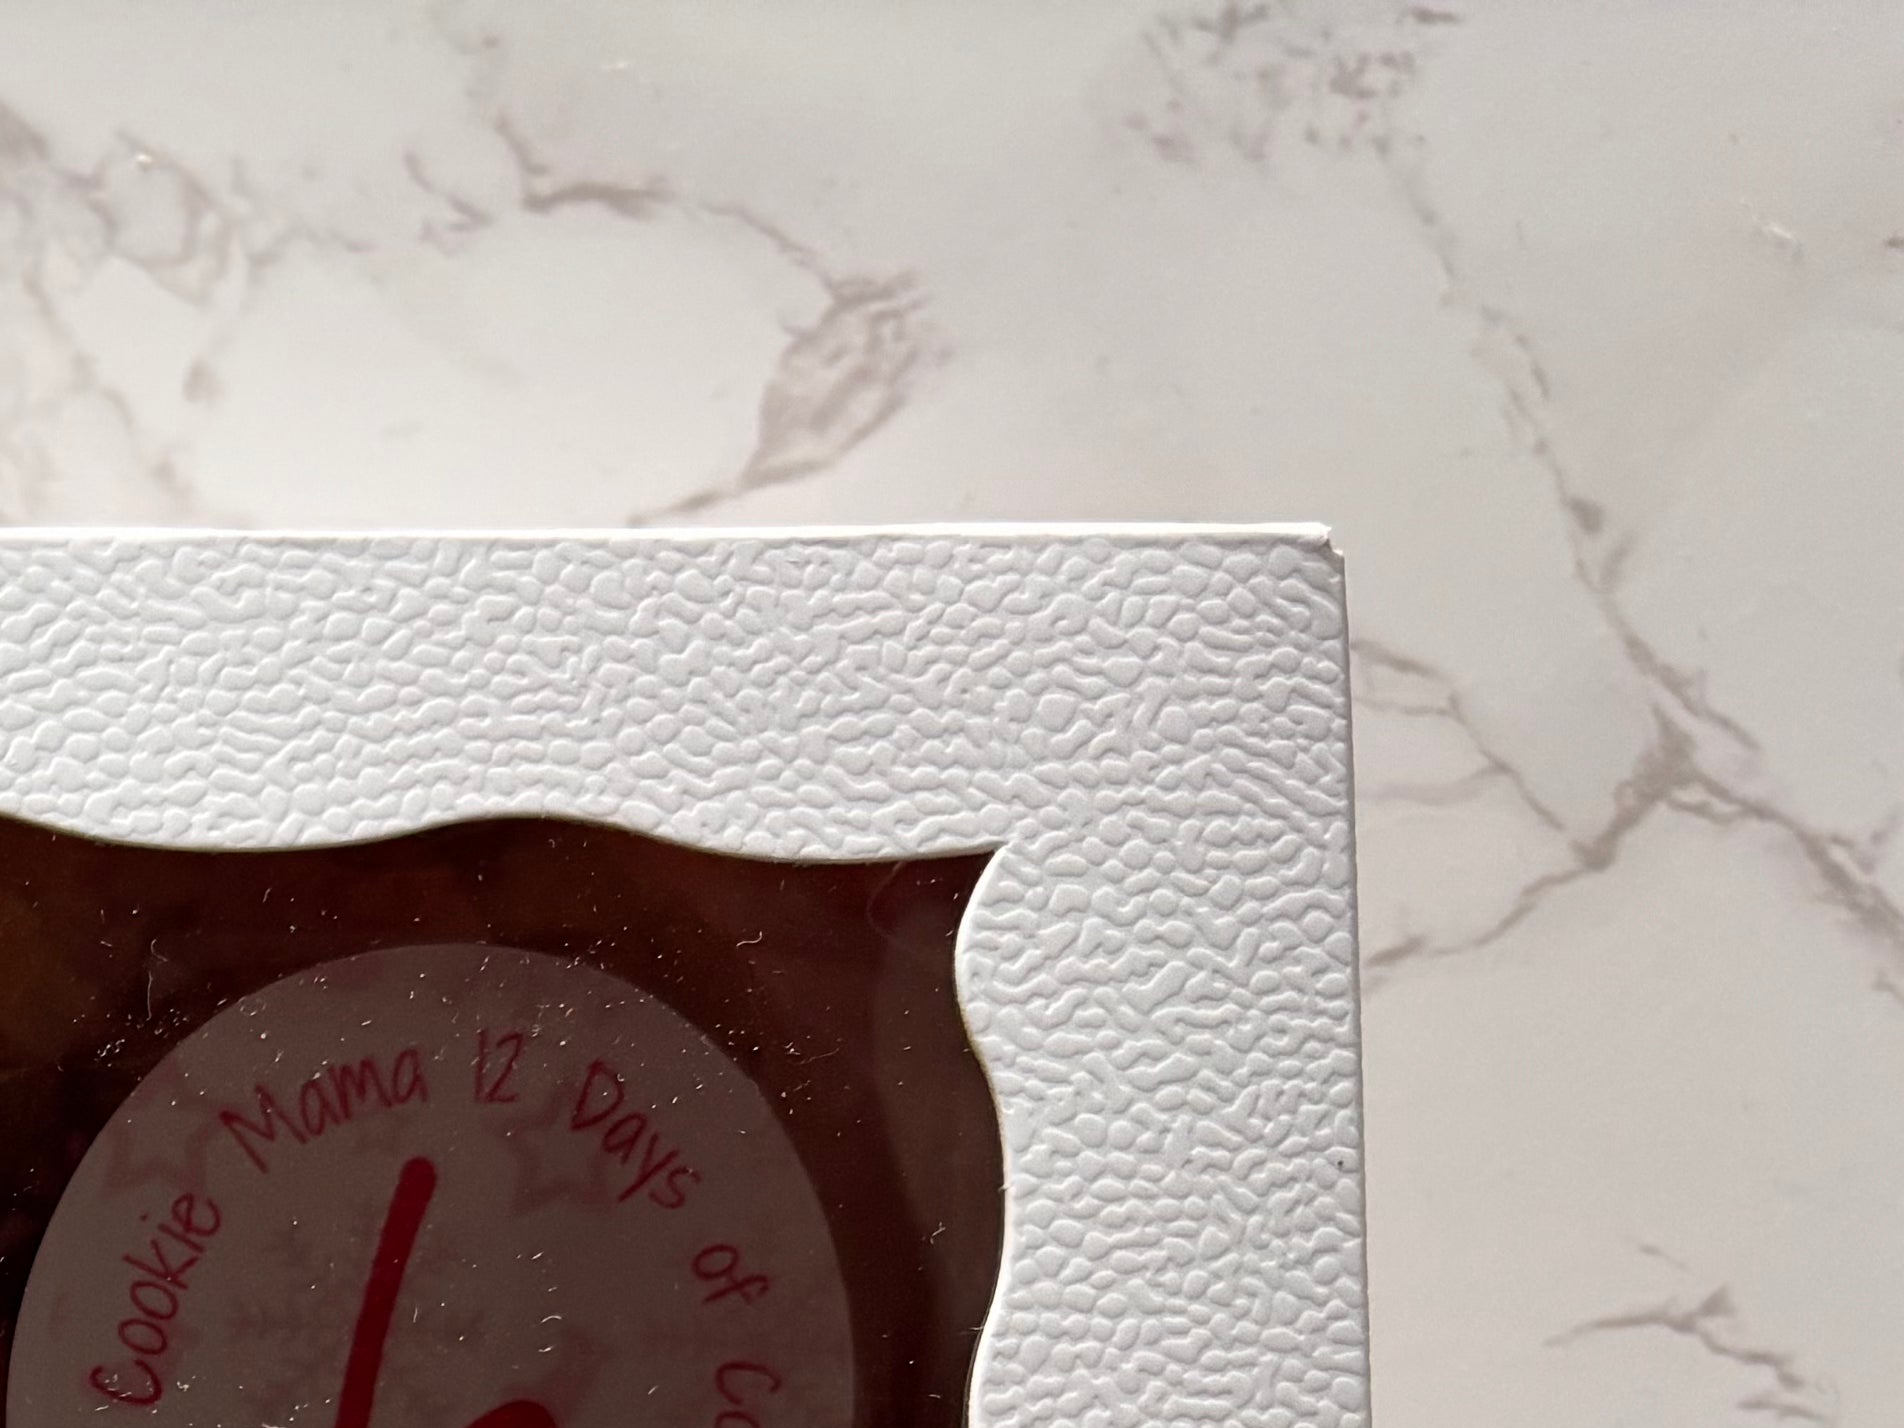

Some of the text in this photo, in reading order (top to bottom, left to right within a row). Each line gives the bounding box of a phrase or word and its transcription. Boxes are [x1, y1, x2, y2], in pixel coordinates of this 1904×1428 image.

[90, 1192, 222, 1406] Cookie
[220, 1047, 427, 1174] Mama
[474, 1030, 526, 1106] 12
[571, 1060, 703, 1210] Days
[693, 1243, 769, 1309] of
